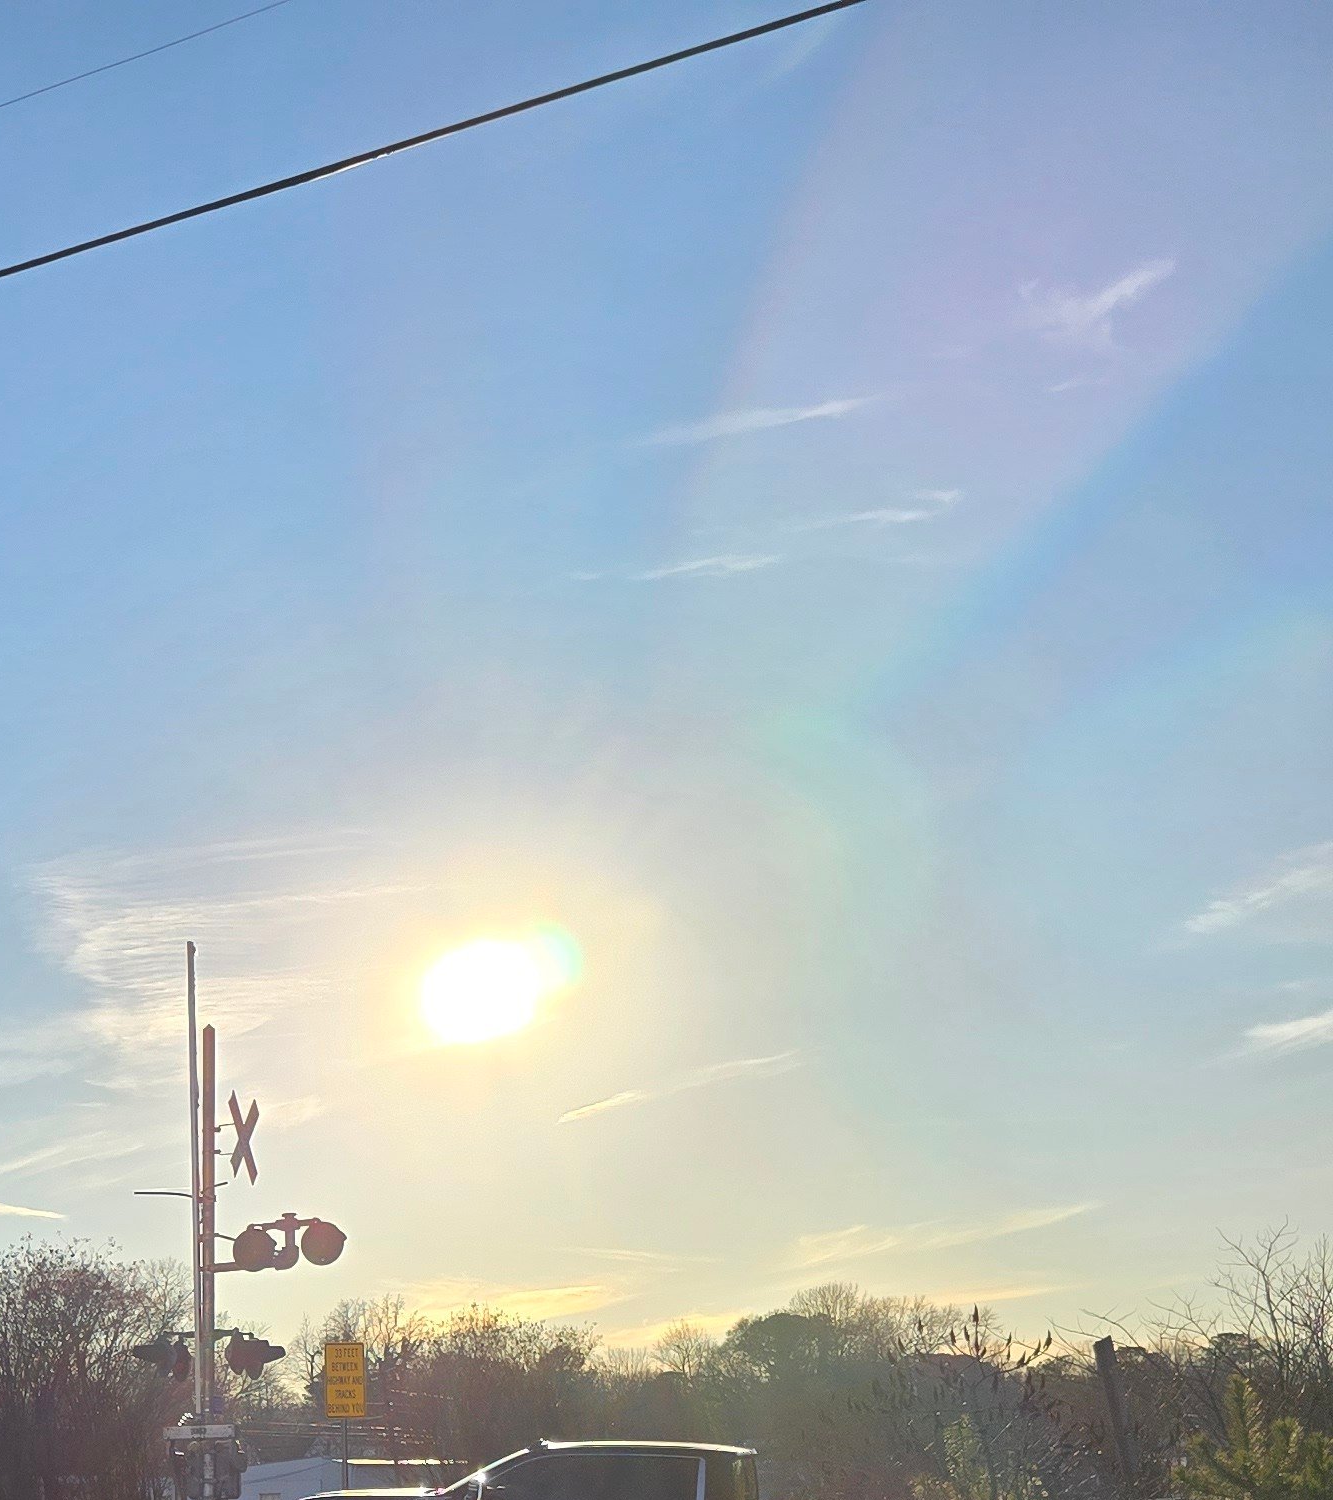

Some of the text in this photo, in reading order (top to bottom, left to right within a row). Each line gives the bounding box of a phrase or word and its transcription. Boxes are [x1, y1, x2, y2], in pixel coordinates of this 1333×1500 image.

[335, 1348, 359, 1358] 33 FEET
[331, 1362, 358, 1371] BETWEEN
[327, 1375, 363, 1386] HIGHWAY AND
[335, 1389, 356, 1399] TRACKS
[328, 1402, 363, 1414] BEHIND YOU
